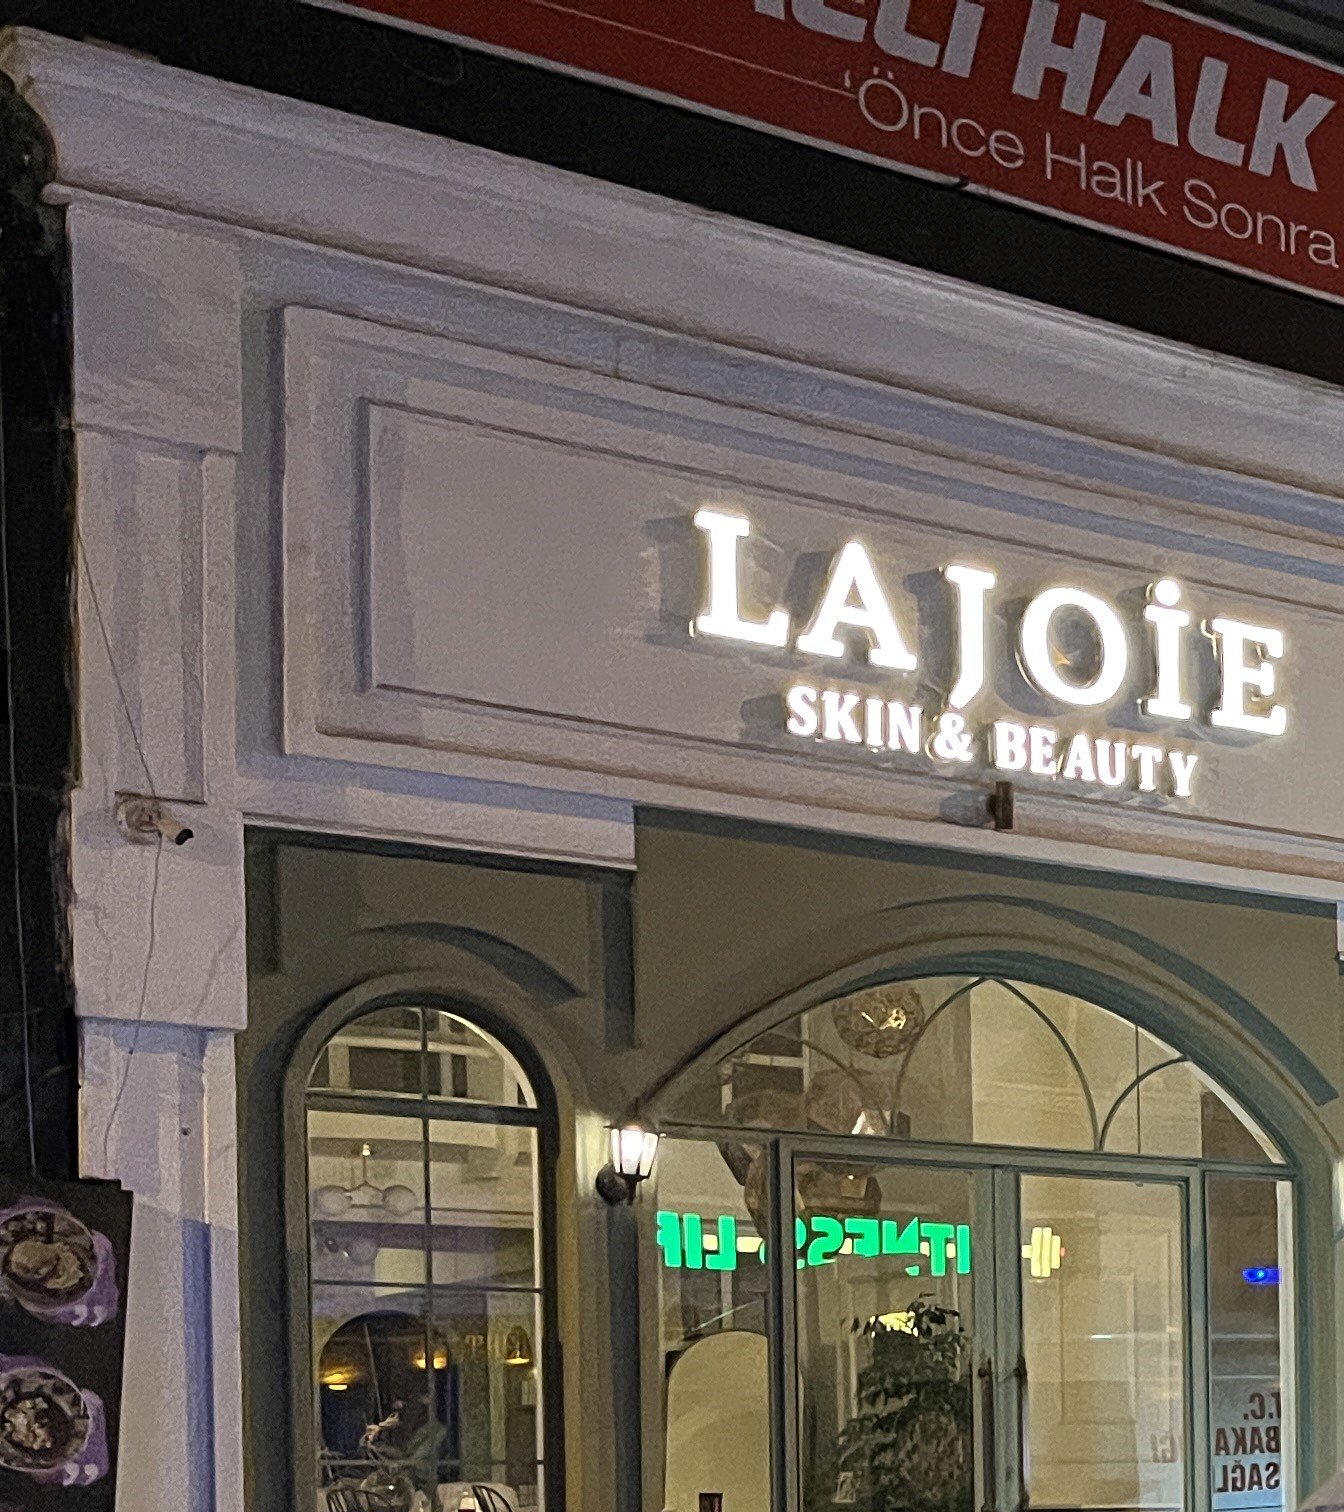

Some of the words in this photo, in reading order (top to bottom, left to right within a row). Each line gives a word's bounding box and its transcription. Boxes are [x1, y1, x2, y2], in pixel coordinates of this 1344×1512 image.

[1012, 0, 1336, 192] HALK
[1045, 132, 1168, 216] Halk
[1183, 178, 1338, 270] Sonra
[993, 720, 1200, 798] BEAUTY
